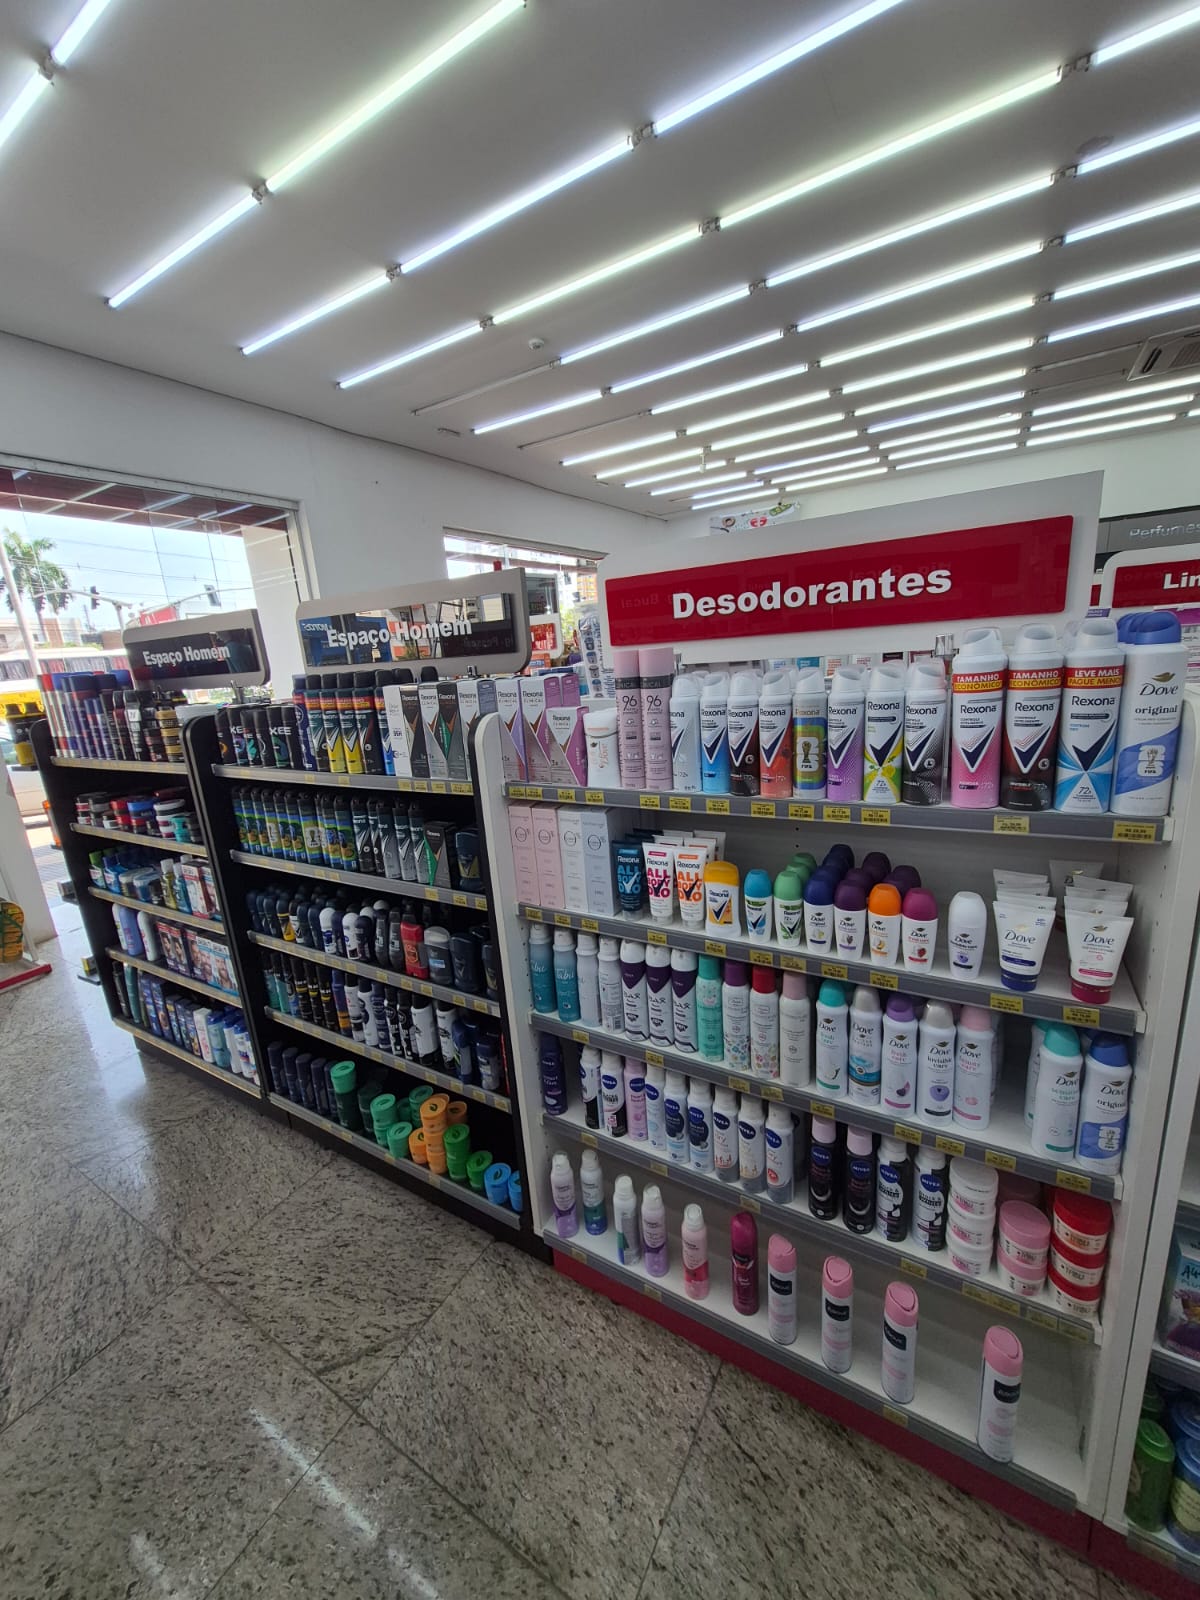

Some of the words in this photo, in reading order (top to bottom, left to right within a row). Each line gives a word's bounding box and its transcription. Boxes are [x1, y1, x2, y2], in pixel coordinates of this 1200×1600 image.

[673, 569, 953, 620] Desodorantes
[327, 627, 390, 650] Espaço
[395, 618, 472, 641] Homem
[143, 650, 183, 667] Espaço
[184, 645, 231, 662] Homem
[1012, 670, 1059, 679] TAMANHO
[1075, 669, 1096, 677] LEVE
[956, 674, 1000, 683] TAMANHO
[1140, 683, 1178, 696] Dove
[622, 695, 638, 712] 96
[646, 695, 662, 712] 96
[868, 702, 900, 710] Rexona
[1072, 696, 1115, 706] Rexona
[829, 706, 857, 715] Rexona
[906, 706, 937, 715] Rexona
[960, 705, 997, 714] Rexona
[1014, 703, 1054, 712] Rexona
[1135, 705, 1178, 716] original
[760, 709, 786, 717] Rexona
[647, 858, 669, 867] Rexona
[677, 861, 700, 869] Rexona
[617, 865, 641, 875] ALL
[647, 867, 671, 879] ALL
[677, 871, 702, 882] ALL
[618, 883, 641, 893] DO
[677, 889, 702, 901] DO
[954, 936, 973, 944] Dove
[1004, 930, 1036, 944] Dove
[1083, 932, 1115, 945] Dove
[819, 1022, 836, 1032] Dove
[852, 1023, 874, 1035] Dove
[889, 1039, 910, 1049] Dove
[929, 1046, 951, 1056] Dove
[959, 1047, 982, 1058] Dove
[812, 1151, 829, 1159] NIVEA
[880, 1168, 898, 1179] NIVEA
[921, 1178, 941, 1187] NIVEA
